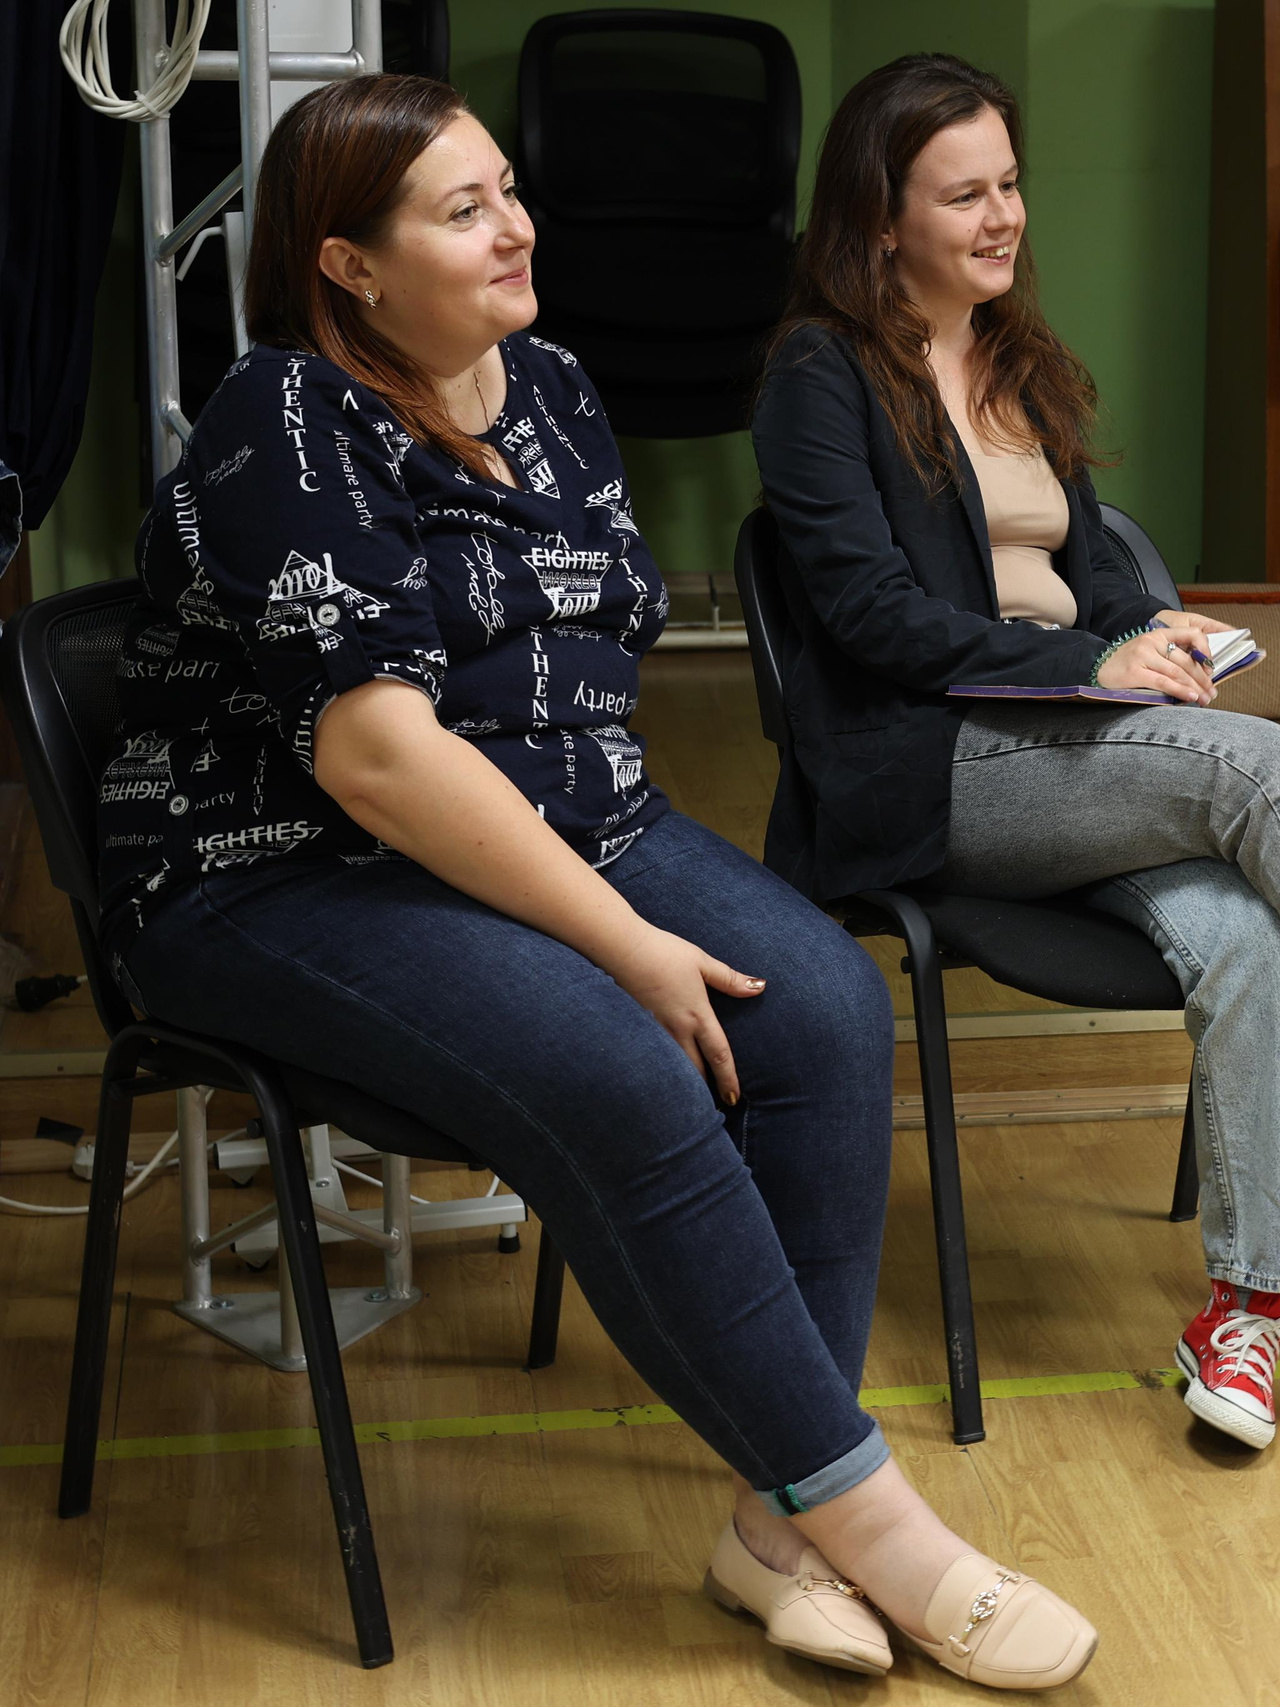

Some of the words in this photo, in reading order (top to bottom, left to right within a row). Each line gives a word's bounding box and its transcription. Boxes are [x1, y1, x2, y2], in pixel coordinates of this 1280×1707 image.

[348, 491, 374, 530] party
[530, 547, 611, 571] EIGHTIES
[540, 570, 599, 590] WORLD
[573, 680, 627, 716] party
[563, 754, 577, 795] party
[99, 780, 171, 804] EIGHTIES
[194, 820, 310, 854] IGHTIES
